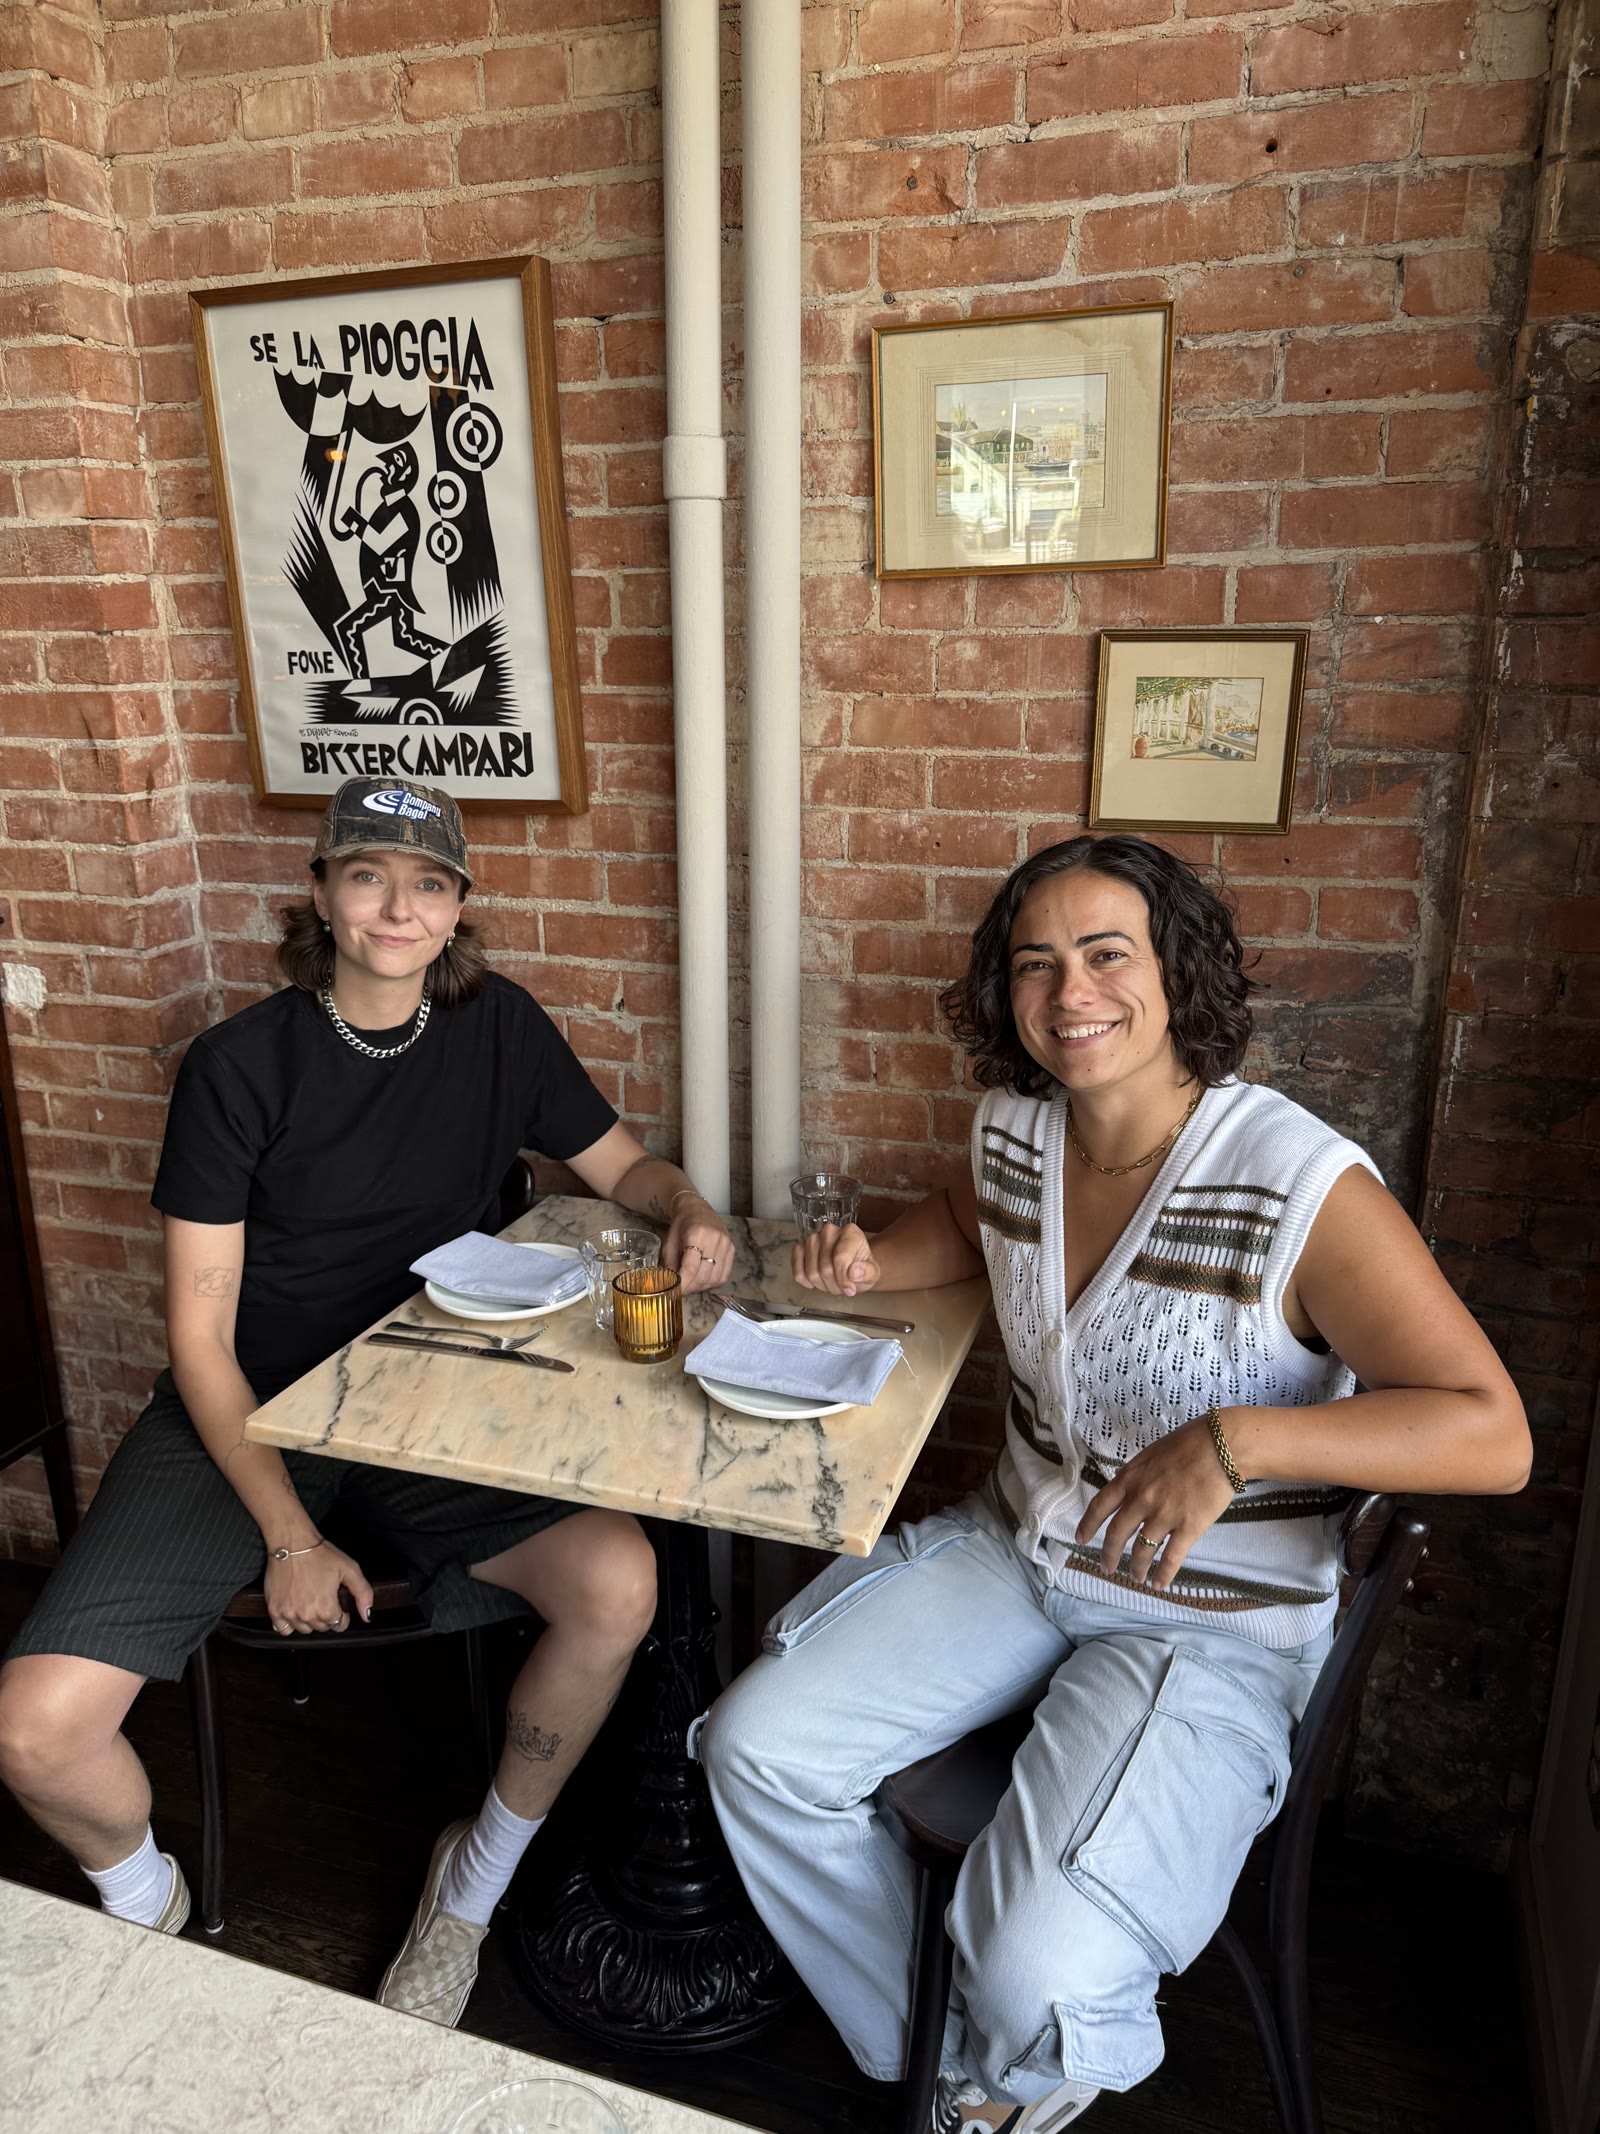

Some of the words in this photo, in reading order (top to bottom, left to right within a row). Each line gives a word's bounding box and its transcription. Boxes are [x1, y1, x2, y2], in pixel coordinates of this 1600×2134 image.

[250, 333, 279, 364] SE
[293, 332, 326, 370] LA
[338, 316, 495, 392] PIOGGIA
[301, 742, 398, 776] BITTER
[396, 732, 535, 778] CAMPARI
[398, 804, 429, 821] Bagel
[402, 792, 442, 818] Company
